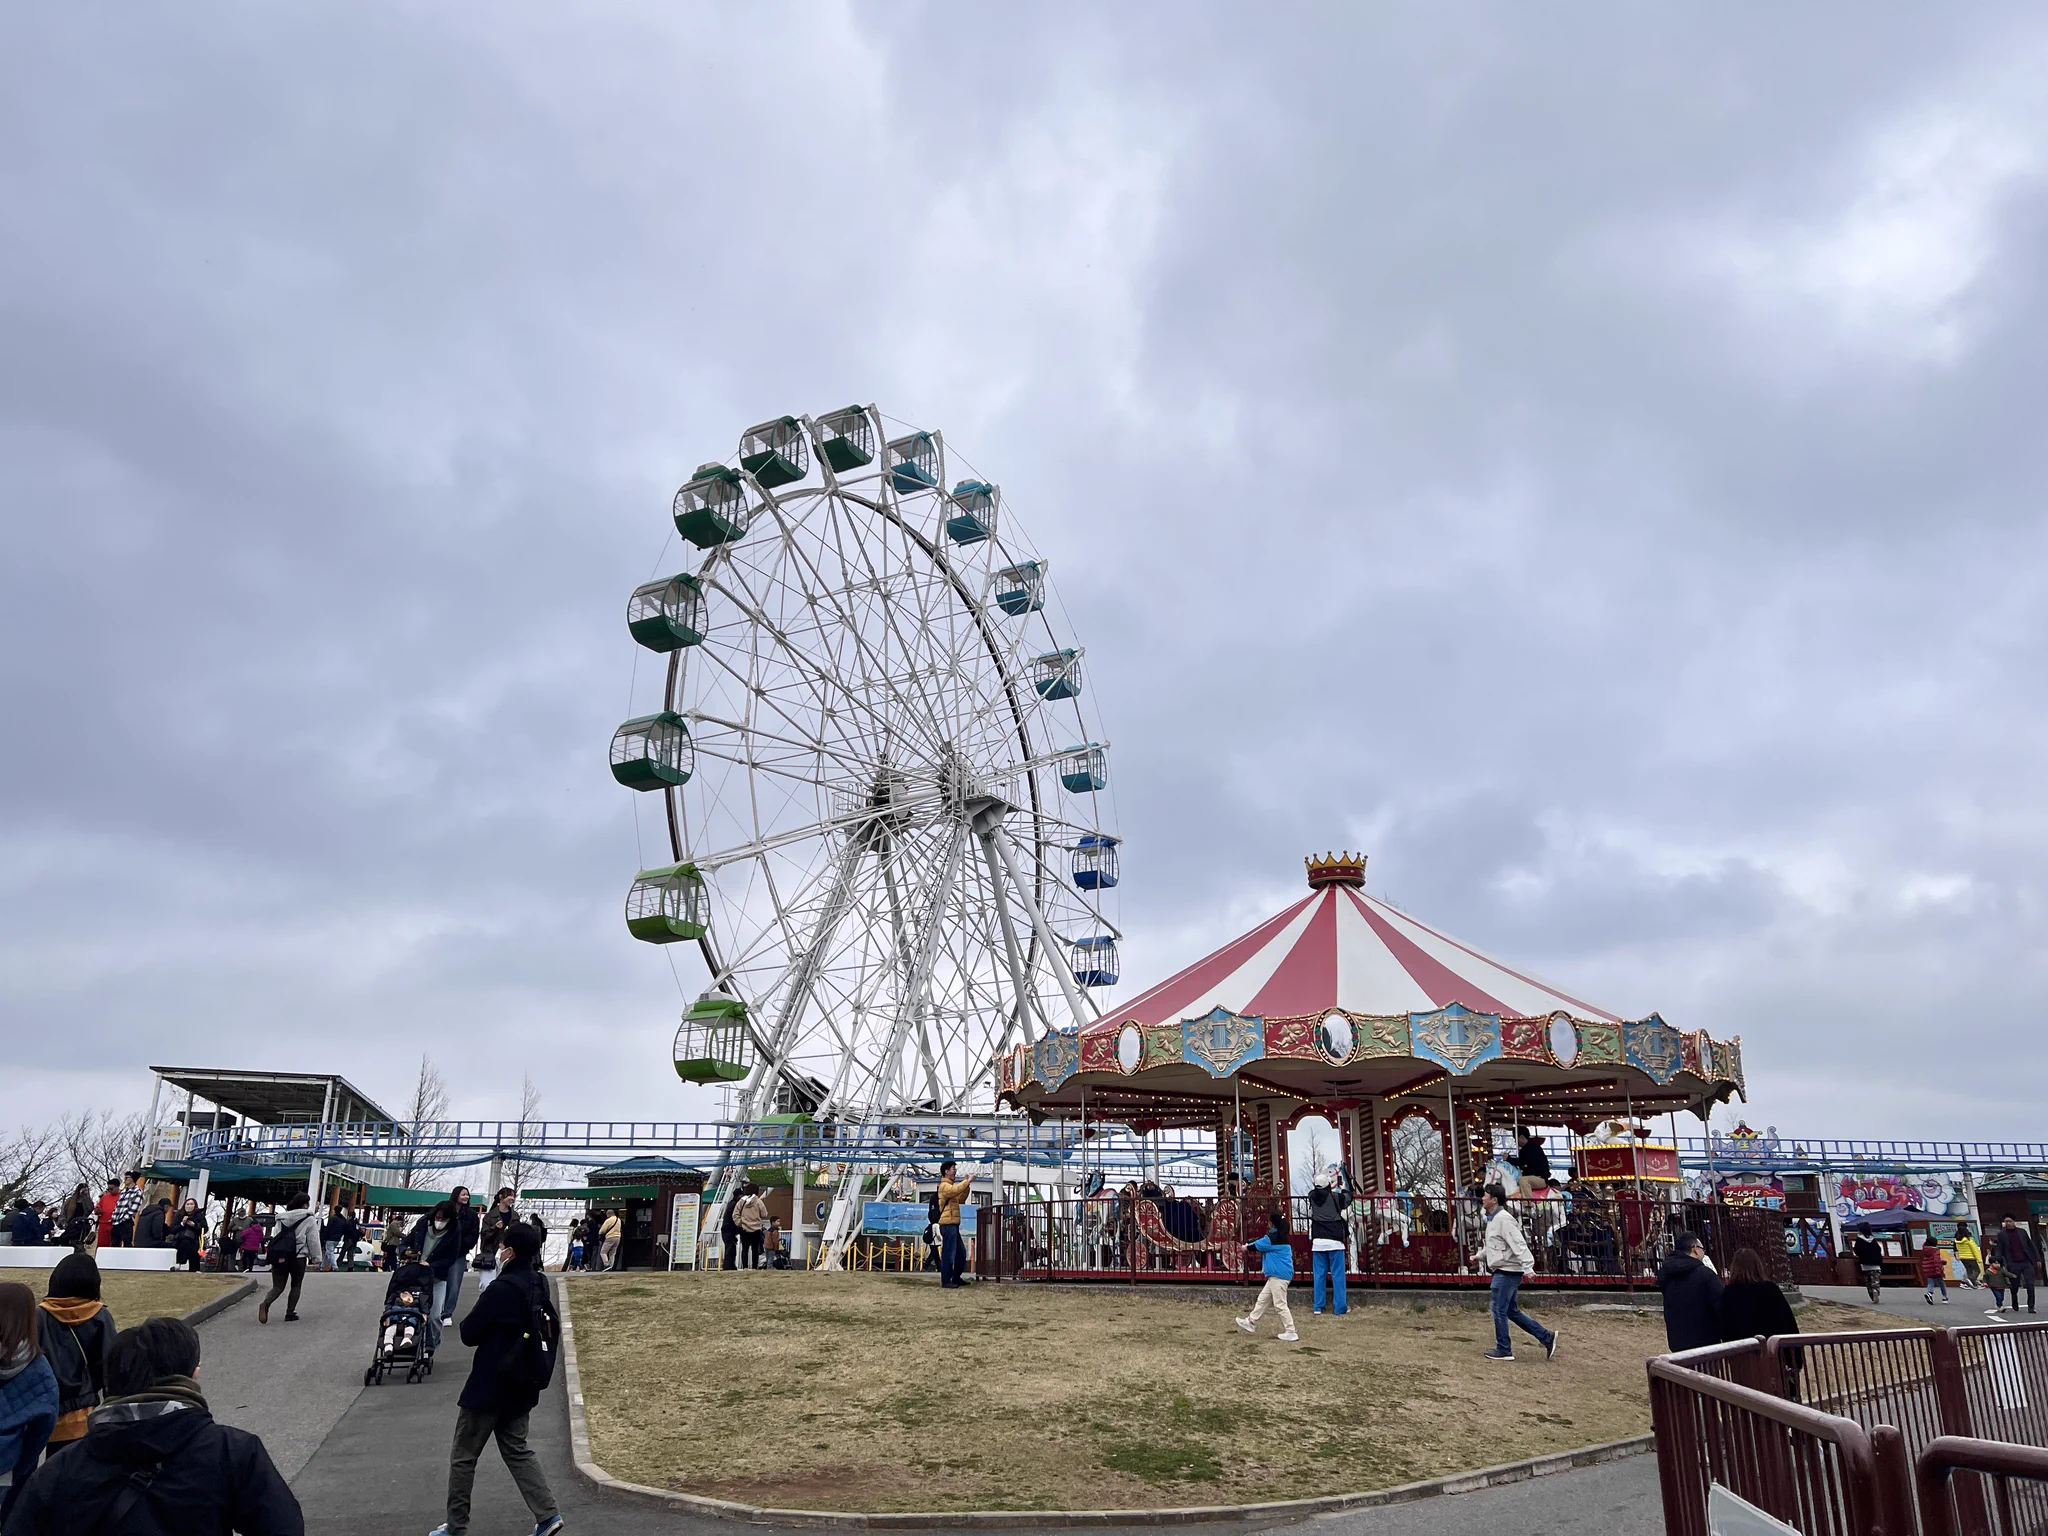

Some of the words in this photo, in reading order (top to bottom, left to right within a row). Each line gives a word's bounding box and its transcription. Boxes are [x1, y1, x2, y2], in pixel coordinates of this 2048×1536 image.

[653, 761, 660, 769] 15
[716, 1061, 722, 1069] 17
[1726, 1189, 1762, 1198] ゲームライド
